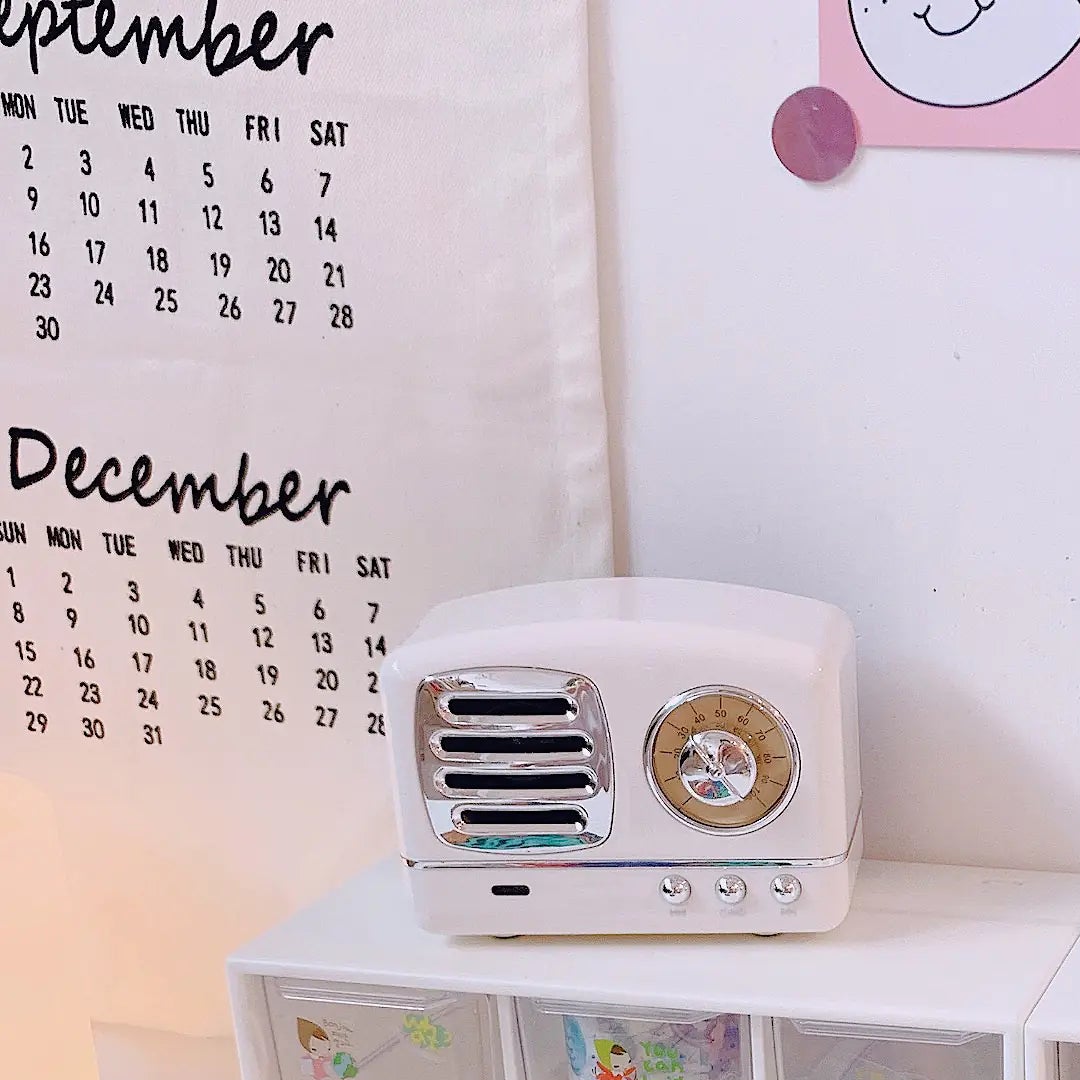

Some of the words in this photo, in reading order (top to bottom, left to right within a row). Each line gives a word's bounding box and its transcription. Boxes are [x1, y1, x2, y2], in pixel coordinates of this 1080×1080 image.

[1, 92, 36, 119] MON
[54, 97, 88, 124] TUE
[118, 103, 154, 130] WED
[176, 109, 209, 136] THU
[246, 115, 280, 142] FRI
[311, 120, 348, 147] SAT
[22, 145, 33, 169] 2
[80, 150, 91, 175] 3
[145, 157, 155, 181] 4
[203, 163, 214, 188] 5
[261, 168, 273, 193] 6
[320, 172, 331, 197] 7
[28, 187, 38, 210] 9
[80, 192, 99, 217] 10
[139, 199, 157, 224] 11
[203, 205, 223, 230] 12
[259, 211, 280, 235] 13
[315, 216, 337, 242] 14
[29, 231, 50, 256] 16
[86, 239, 105, 264] 17
[147, 246, 168, 272] 18
[211, 252, 230, 277] 19
[267, 257, 290, 283] 20
[324, 262, 344, 287] 21
[29, 272, 51, 298] 23
[94, 280, 114, 306] 24
[155, 287, 178, 313] 25
[219, 294, 241, 320] 26
[274, 299, 296, 324] 27
[330, 304, 353, 328] 28
[36, 315, 59, 340] 30
[8, 427, 351, 526] December
[47, 526, 82, 550] MON
[102, 533, 136, 556] TUE
[168, 540, 203, 563] WED
[226, 545, 262, 568] THU
[298, 551, 329, 574] FRI
[357, 556, 391, 579] SAT
[7, 567, 15, 587] 1
[62, 572, 72, 594] 2
[128, 581, 139, 602] 3
[193, 589, 204, 608] 4
[255, 594, 265, 615] 5
[314, 600, 325, 620] 6
[368, 603, 379, 623] 7
[13, 602, 24, 623] 8
[67, 608, 77, 628] 9
[128, 614, 149, 635] 10
[189, 621, 208, 642] 11
[253, 627, 274, 648] 12
[312, 632, 333, 653] 13
[365, 636, 386, 657] 14
[15, 640, 36, 661] 15
[74, 647, 95, 669] 16
[132, 652, 152, 673] 17
[195, 659, 216, 680] 18
[257, 665, 278, 685] 19
[316, 668, 339, 691] 20
[368, 672, 378, 693] 2
[23, 675, 43, 697] 22
[80, 682, 100, 704] 23
[138, 688, 158, 710] 24
[198, 695, 221, 716] 25
[263, 701, 284, 723] 26
[316, 706, 338, 728] 27
[26, 711, 47, 733] 29
[82, 718, 104, 739] 30
[144, 725, 162, 744] 31
[694, 713, 706, 724] 40
[714, 709, 727, 718] 50
[737, 715, 750, 726] 60
[755, 729, 766, 741] 70
